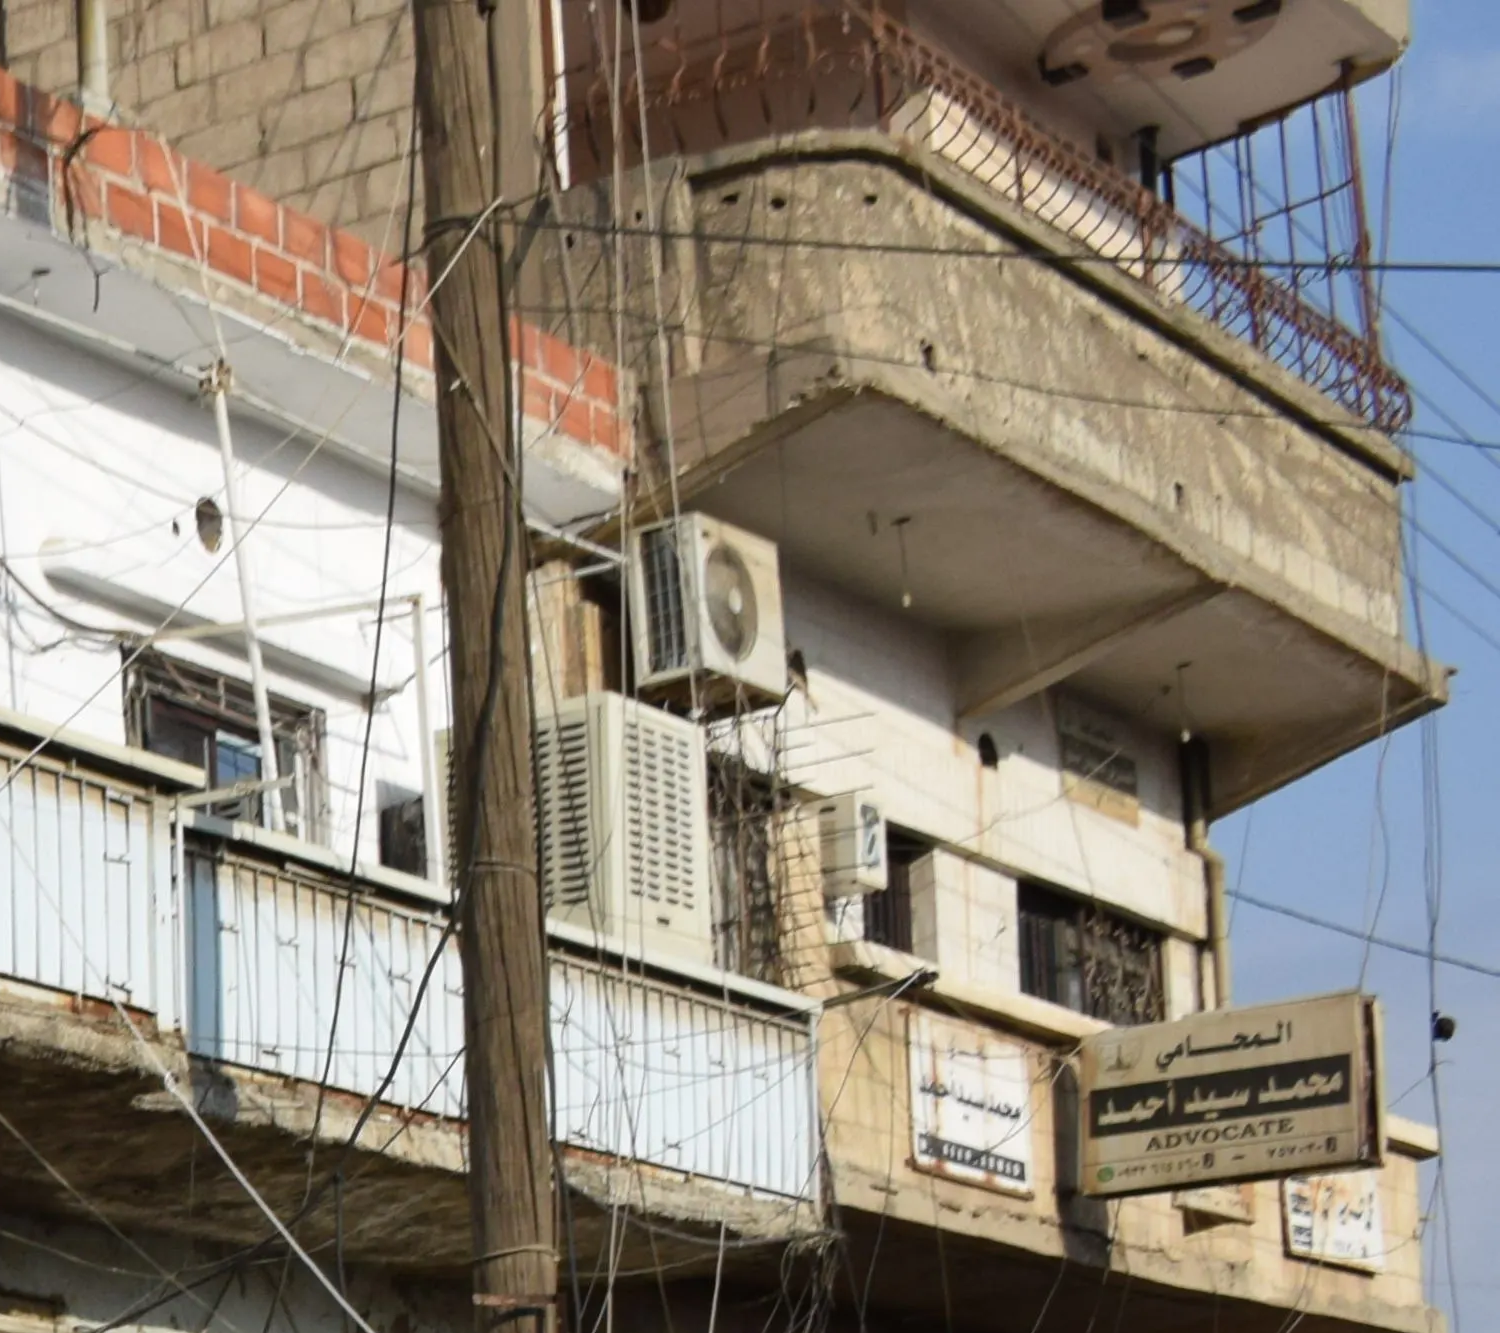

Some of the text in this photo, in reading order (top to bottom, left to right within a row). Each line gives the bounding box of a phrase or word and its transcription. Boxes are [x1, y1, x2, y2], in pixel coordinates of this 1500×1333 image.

[1155, 1020, 1292, 1073] المحامي
[1097, 1069, 1344, 1126] محمد سيد أحمد
[1145, 1117, 1295, 1152] ADVOCATE
